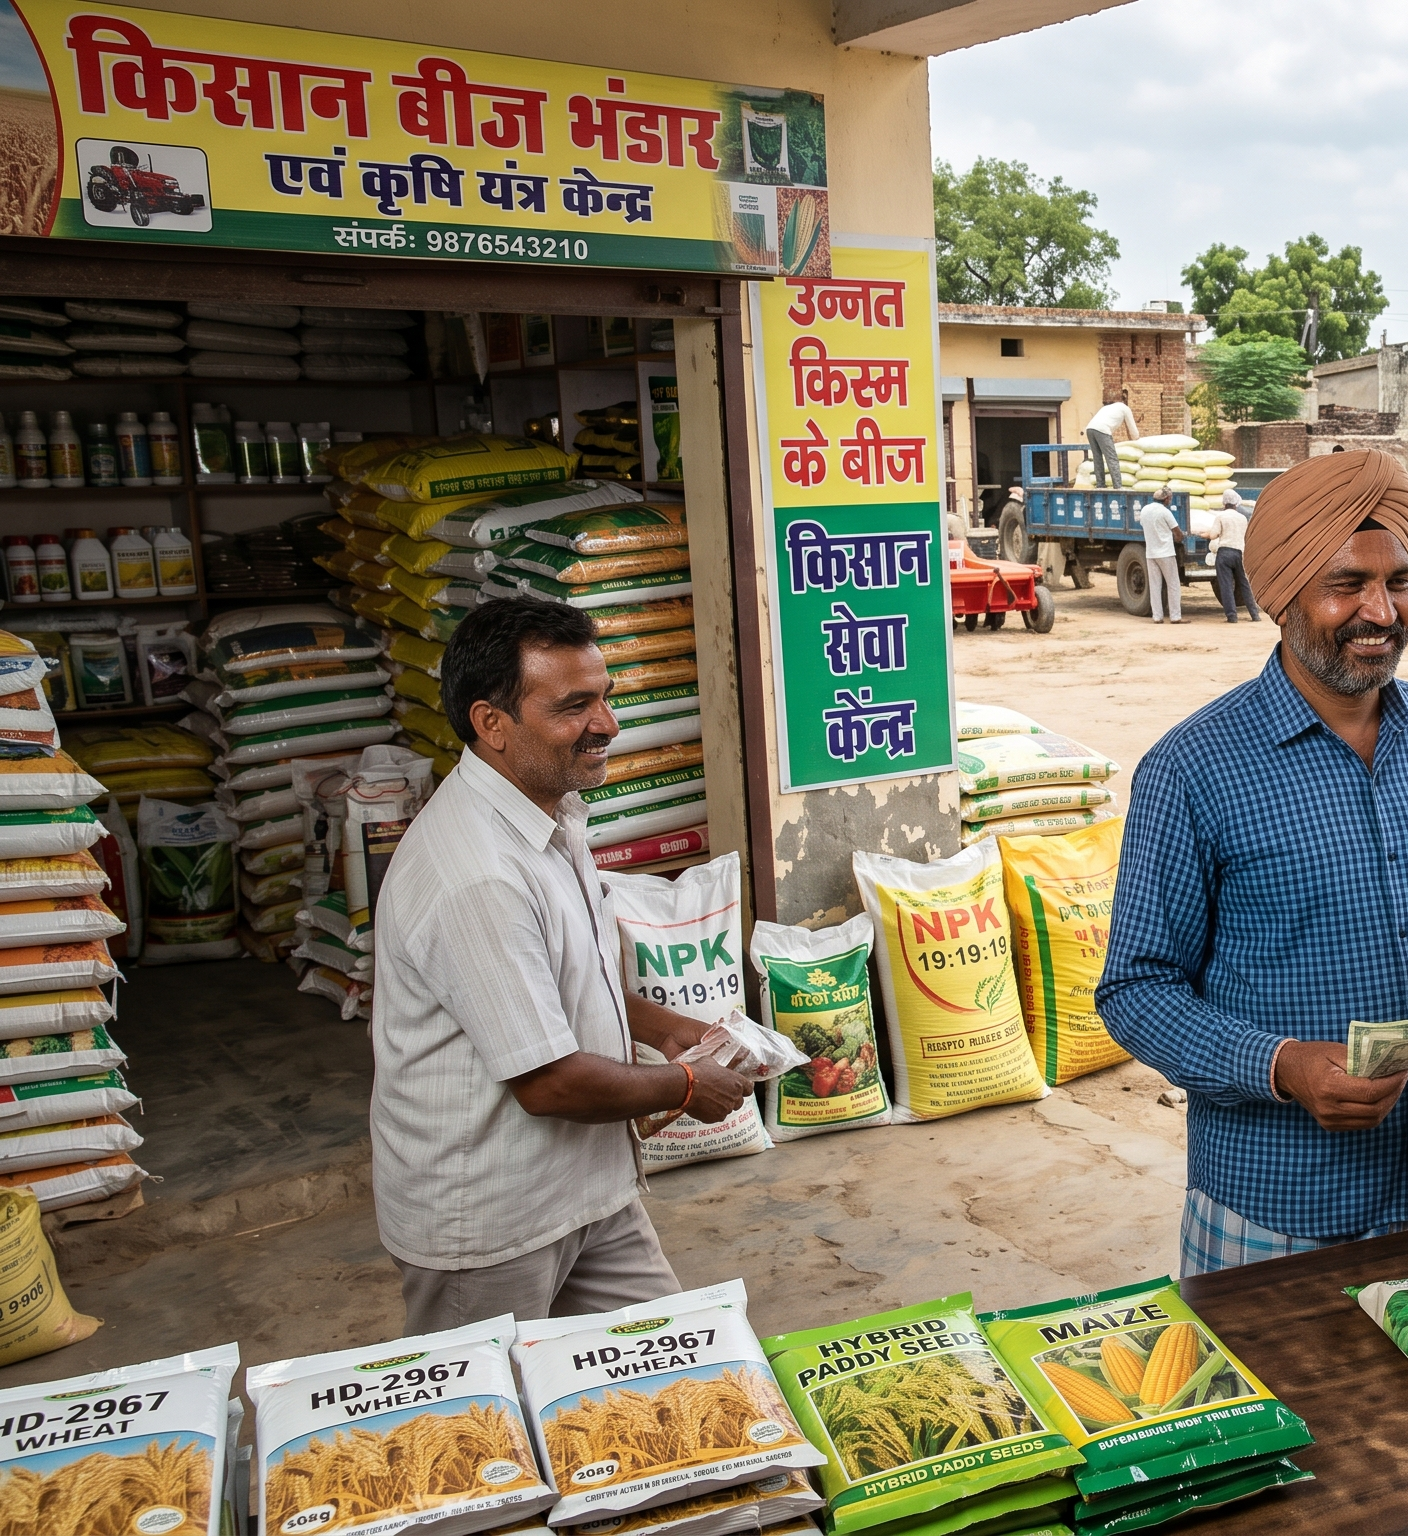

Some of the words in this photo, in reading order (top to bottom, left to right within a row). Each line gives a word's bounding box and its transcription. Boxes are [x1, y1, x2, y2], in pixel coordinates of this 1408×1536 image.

[66, 14, 372, 138] किसान
[391, 57, 547, 154] बीज
[568, 77, 721, 171] भंडार
[265, 146, 346, 198] एवं
[358, 154, 465, 216] कृषि
[477, 160, 549, 213] यंत्र
[560, 168, 653, 223] केन्द्र
[426, 230, 589, 260] 9876543210
[786, 278, 905, 328] उन्नत
[789, 337, 909, 408] किस्म
[781, 419, 829, 487] के
[841, 418, 927, 485] बीज
[787, 521, 931, 593] किसान
[822, 603, 908, 676] सेवा
[910, 896, 1002, 945] NPK
[634, 929, 736, 978] NPK
[918, 935, 1007, 972] 19:19:19
[637, 973, 739, 1007] 19:19:19
[817, 1319, 947, 1358] HYBRID
[1039, 1303, 1170, 1345] MAIZE
[571, 1328, 717, 1372] HD-2967
[604, 1351, 699, 1380] WHEAT
[797, 1345, 891, 1389] PADDY
[900, 1330, 989, 1356] SEEDS
[310, 1359, 470, 1411] HD-2967
[344, 1384, 448, 1418] WHEAT
[15, 1418, 136, 1453] WHEAT
[864, 1469, 928, 1497] HYBRID
[931, 1452, 986, 1477] PADDY
[990, 1439, 1045, 1462] SEEDS
